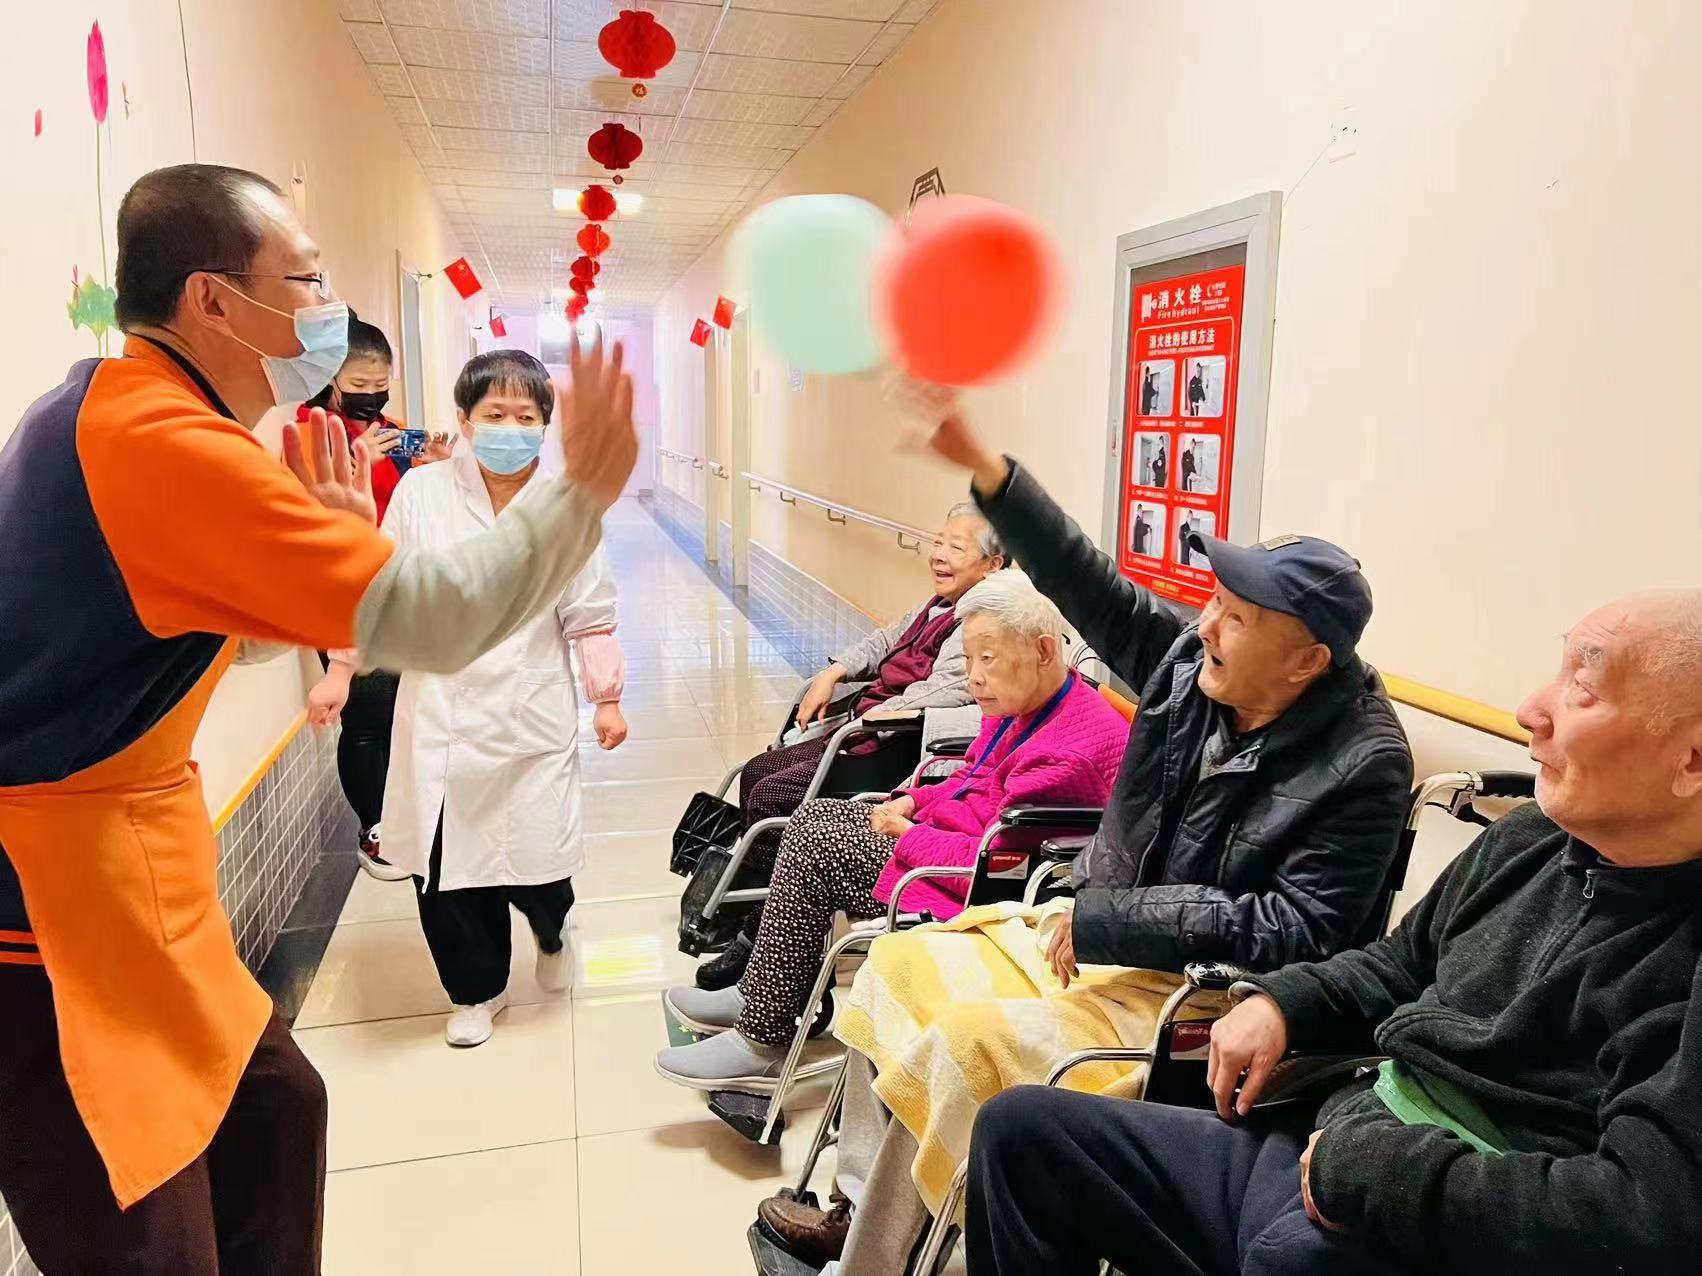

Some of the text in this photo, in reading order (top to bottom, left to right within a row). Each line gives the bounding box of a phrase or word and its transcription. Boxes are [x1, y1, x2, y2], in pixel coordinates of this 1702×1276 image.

[1158, 284, 1202, 309] 消火栓
[1158, 309, 1171, 319] Fire
[1171, 306, 1200, 318] hydrant
[1149, 327, 1215, 349] 消火栓的使用方法
